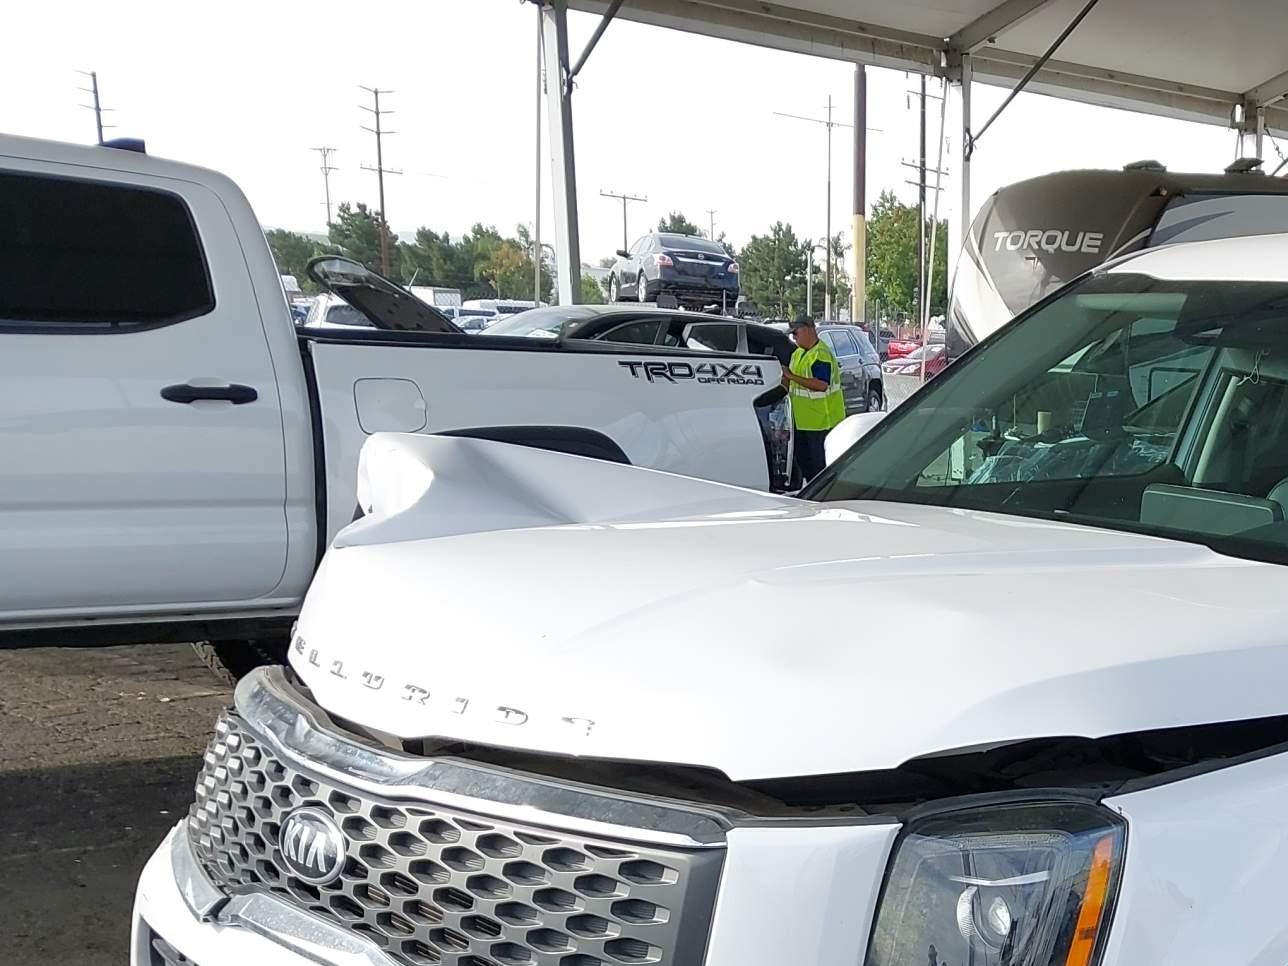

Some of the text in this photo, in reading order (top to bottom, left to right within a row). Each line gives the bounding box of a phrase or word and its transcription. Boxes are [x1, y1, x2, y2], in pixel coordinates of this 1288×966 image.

[993, 229, 1104, 254] TORQUE
[617, 361, 695, 384] TRD
[727, 377, 765, 385] ROAD
[283, 818, 327, 873] KIA
